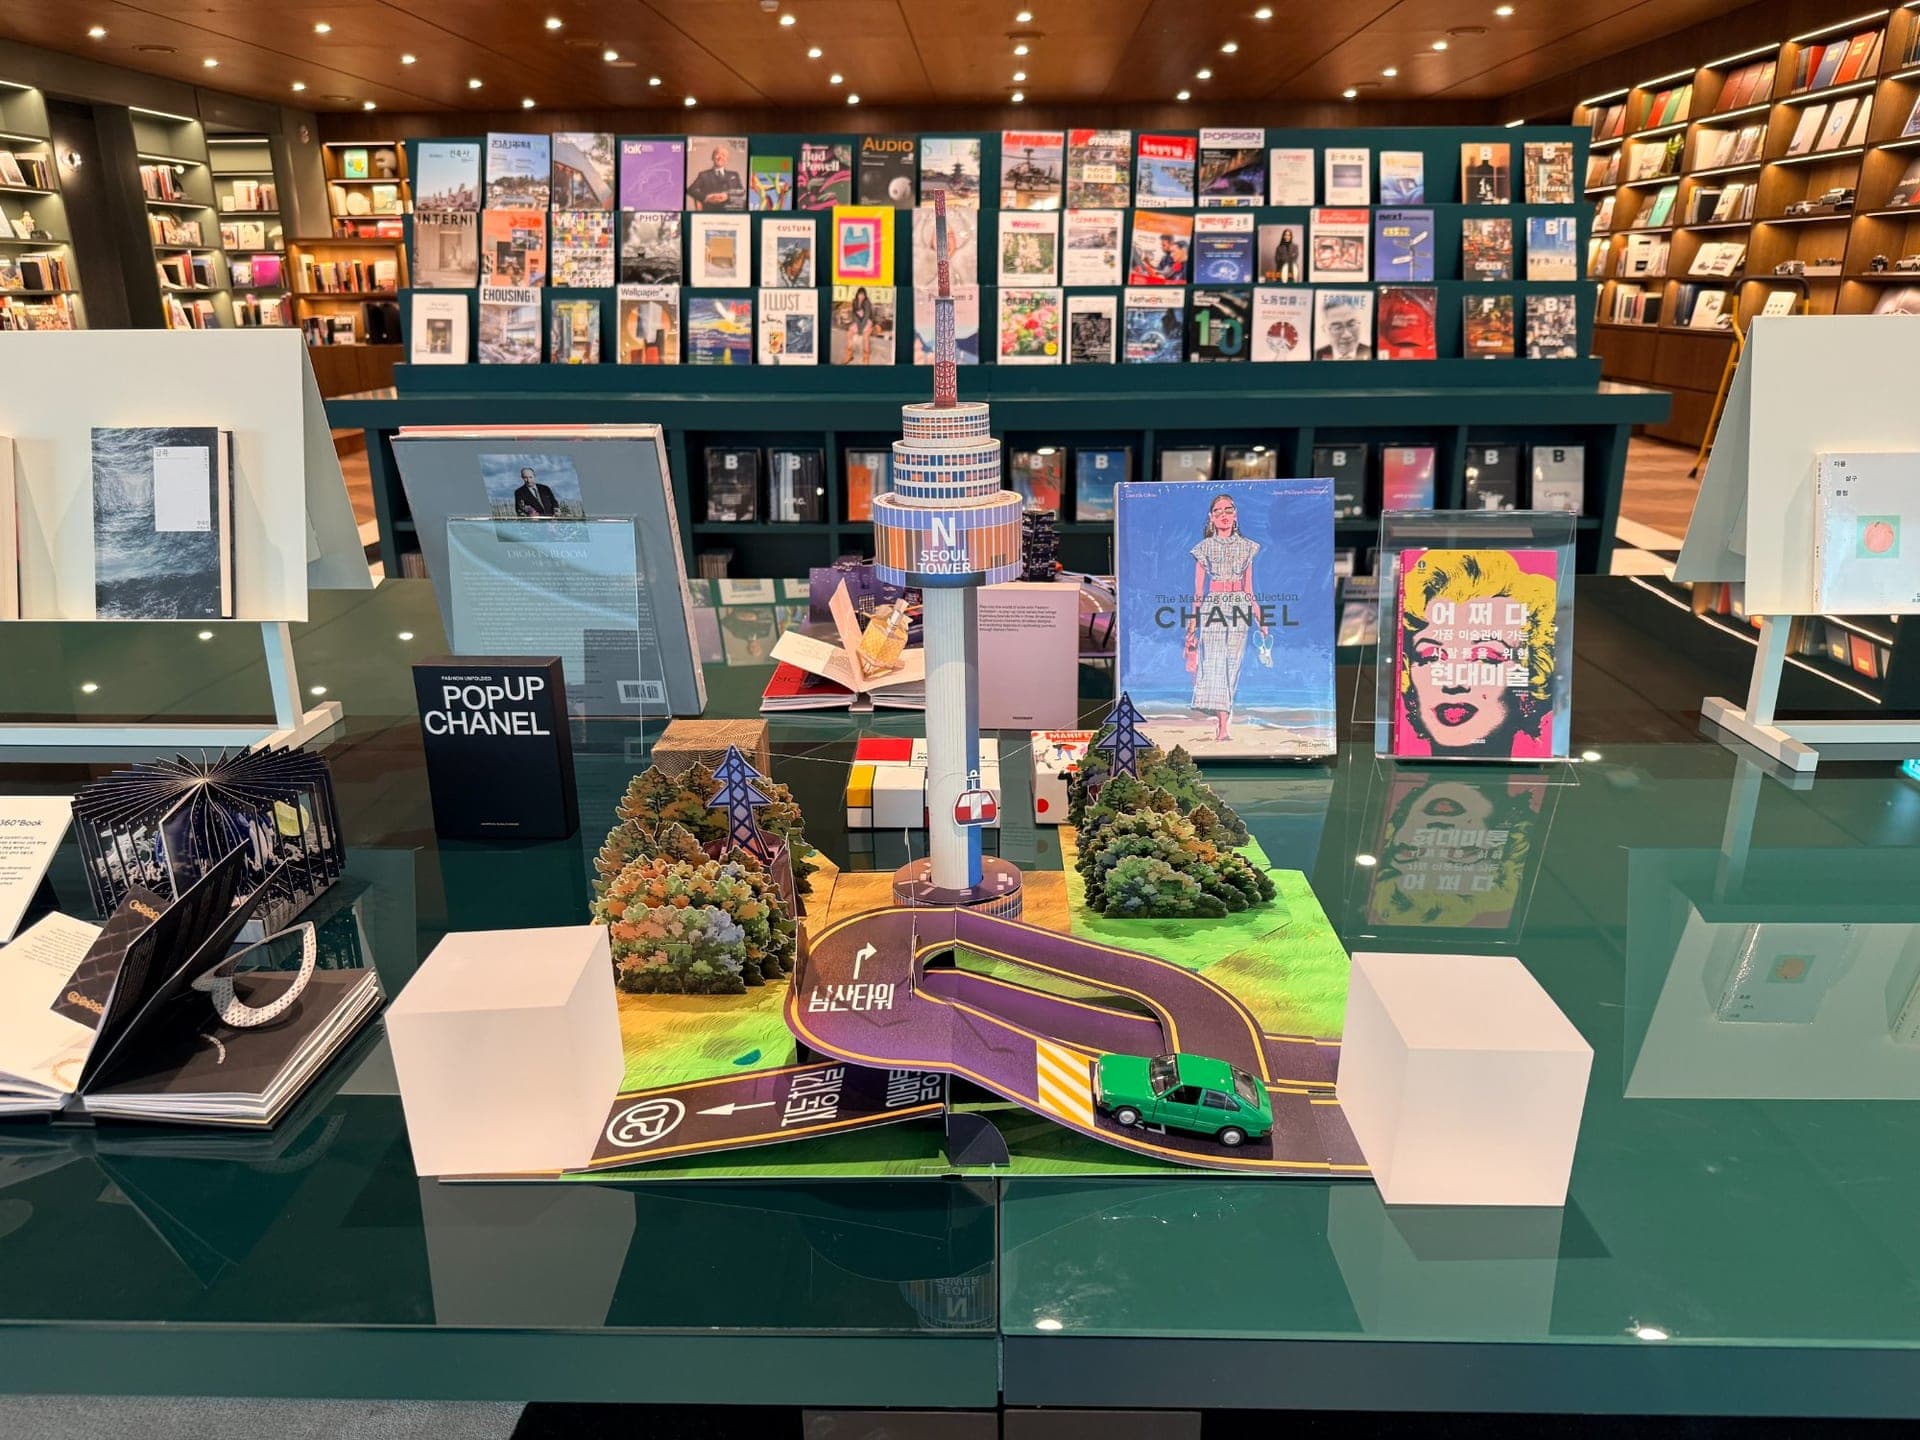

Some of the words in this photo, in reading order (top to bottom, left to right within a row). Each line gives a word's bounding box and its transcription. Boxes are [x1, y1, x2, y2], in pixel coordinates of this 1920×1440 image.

[417, 213, 473, 226] INTERNI
[725, 455, 738, 469] B
[866, 455, 879, 469] B
[1030, 454, 1043, 469] B
[1095, 454, 1108, 469] B
[1332, 451, 1346, 466] B
[1403, 449, 1416, 465] B
[1485, 450, 1499, 465] B
[1553, 449, 1565, 462] B
[931, 517, 956, 547] N
[920, 549, 969, 561] SEOUL
[918, 562, 972, 575] TOWER
[1155, 595, 1176, 604] The
[1180, 594, 1220, 605] Making
[1245, 592, 1299, 602] Collection
[1155, 604, 1299, 629] CHANEL
[1506, 629, 1529, 641] 가는
[1503, 646, 1529, 660] 위한
[1431, 663, 1529, 687] 현대미술
[424, 710, 551, 736] CHANEL
[808, 983, 895, 1013] 남산타워
[618, 1103, 668, 1140] 20
